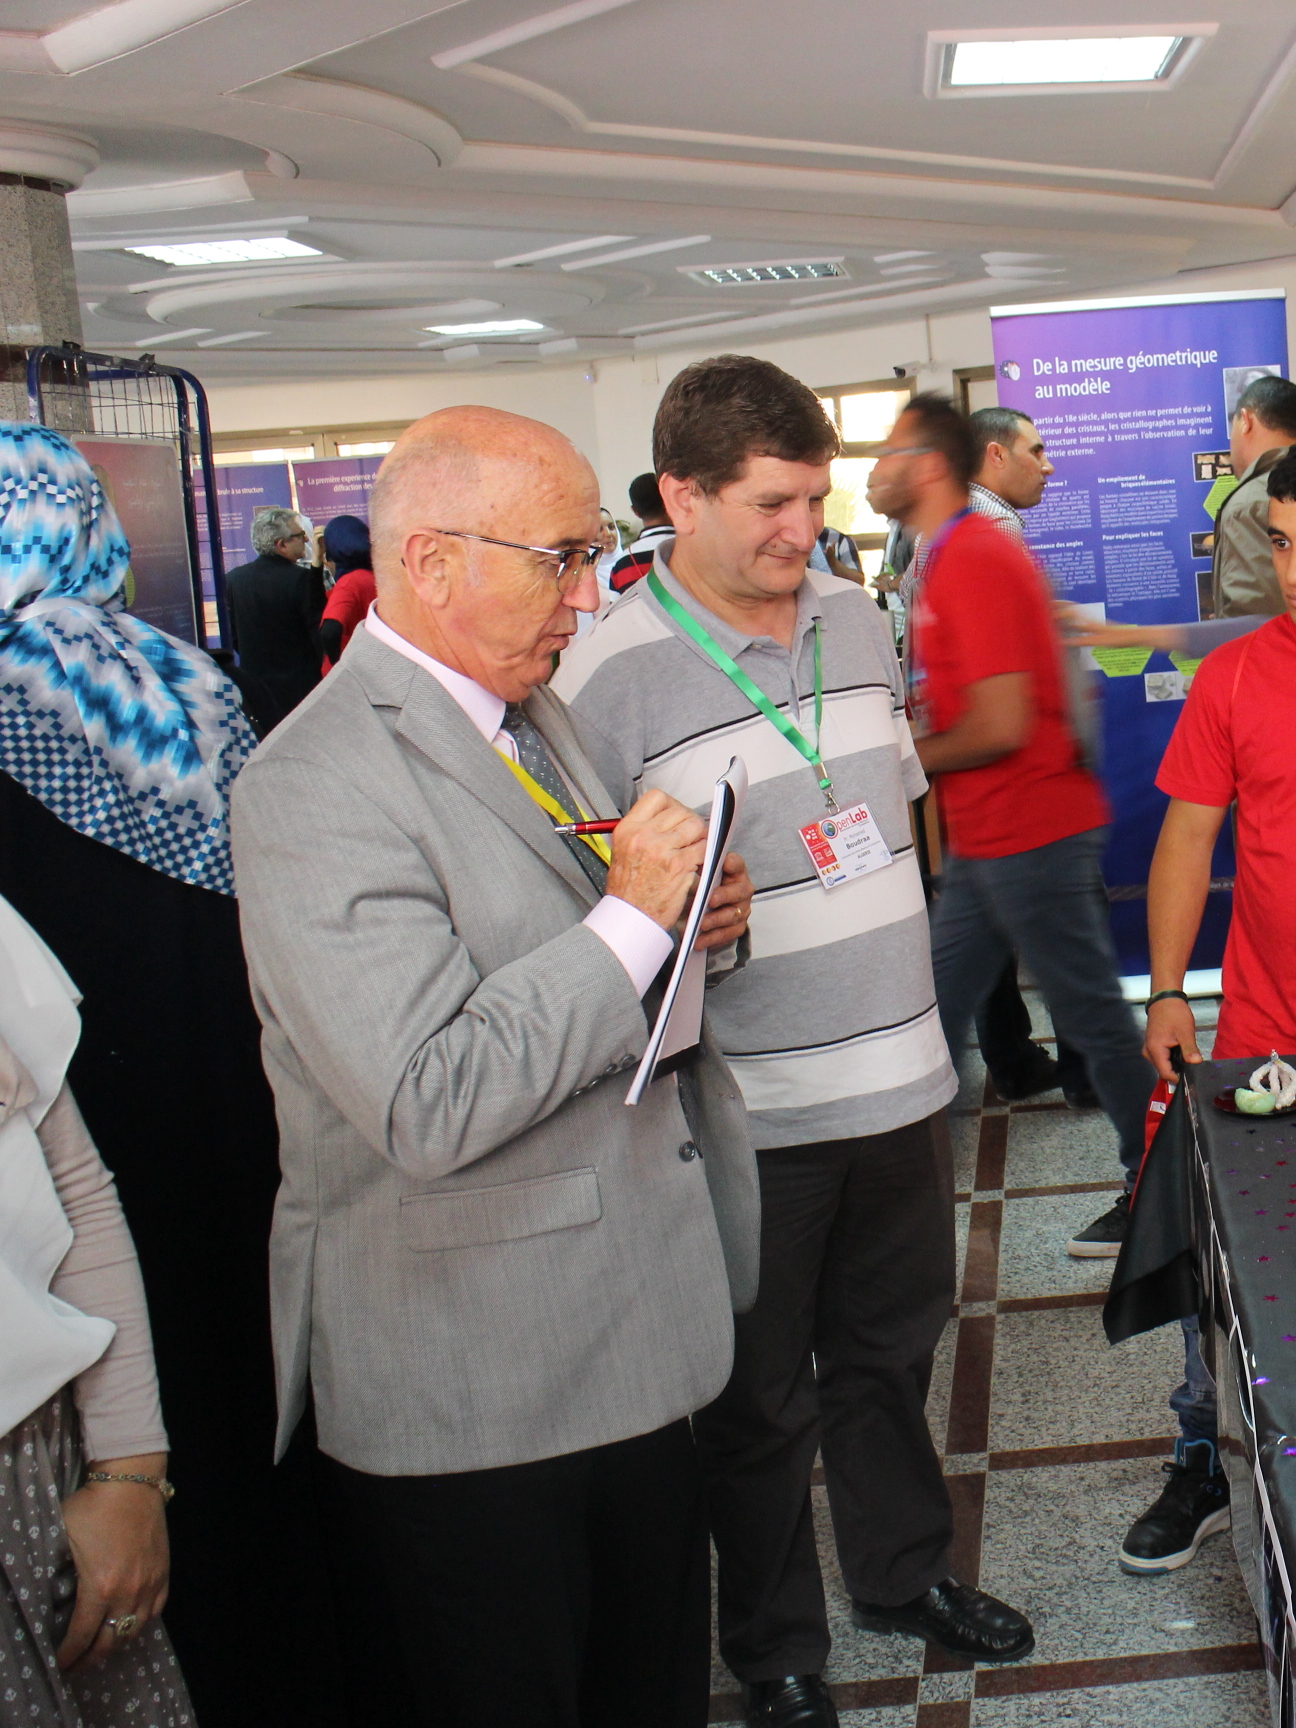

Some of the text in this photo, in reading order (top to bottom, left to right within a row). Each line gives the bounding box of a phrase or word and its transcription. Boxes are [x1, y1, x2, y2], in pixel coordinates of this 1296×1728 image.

[1033, 348, 1218, 375] De la mesure géometrique
[1035, 378, 1110, 399] au modèle
[1034, 415, 1053, 426] partir
[1055, 415, 1063, 423] du
[1065, 414, 1077, 422] 18e
[1078, 412, 1100, 422] siècle,
[1101, 411, 1117, 420] alors
[1119, 410, 1132, 419] que
[1133, 409, 1146, 417] rien
[1157, 406, 1182, 417] permet
[1193, 405, 1206, 413] voir
[1078, 423, 1107, 433] cristaux,
[1109, 421, 1119, 430] les
[1121, 418, 1175, 431] cristallographes
[1177, 416, 1212, 426] imaginent
[1046, 427, 1212, 447] structure interne travers l'observation de leur
[1044, 448, 1095, 458] métrie externe.
[316, 476, 340, 485] première
